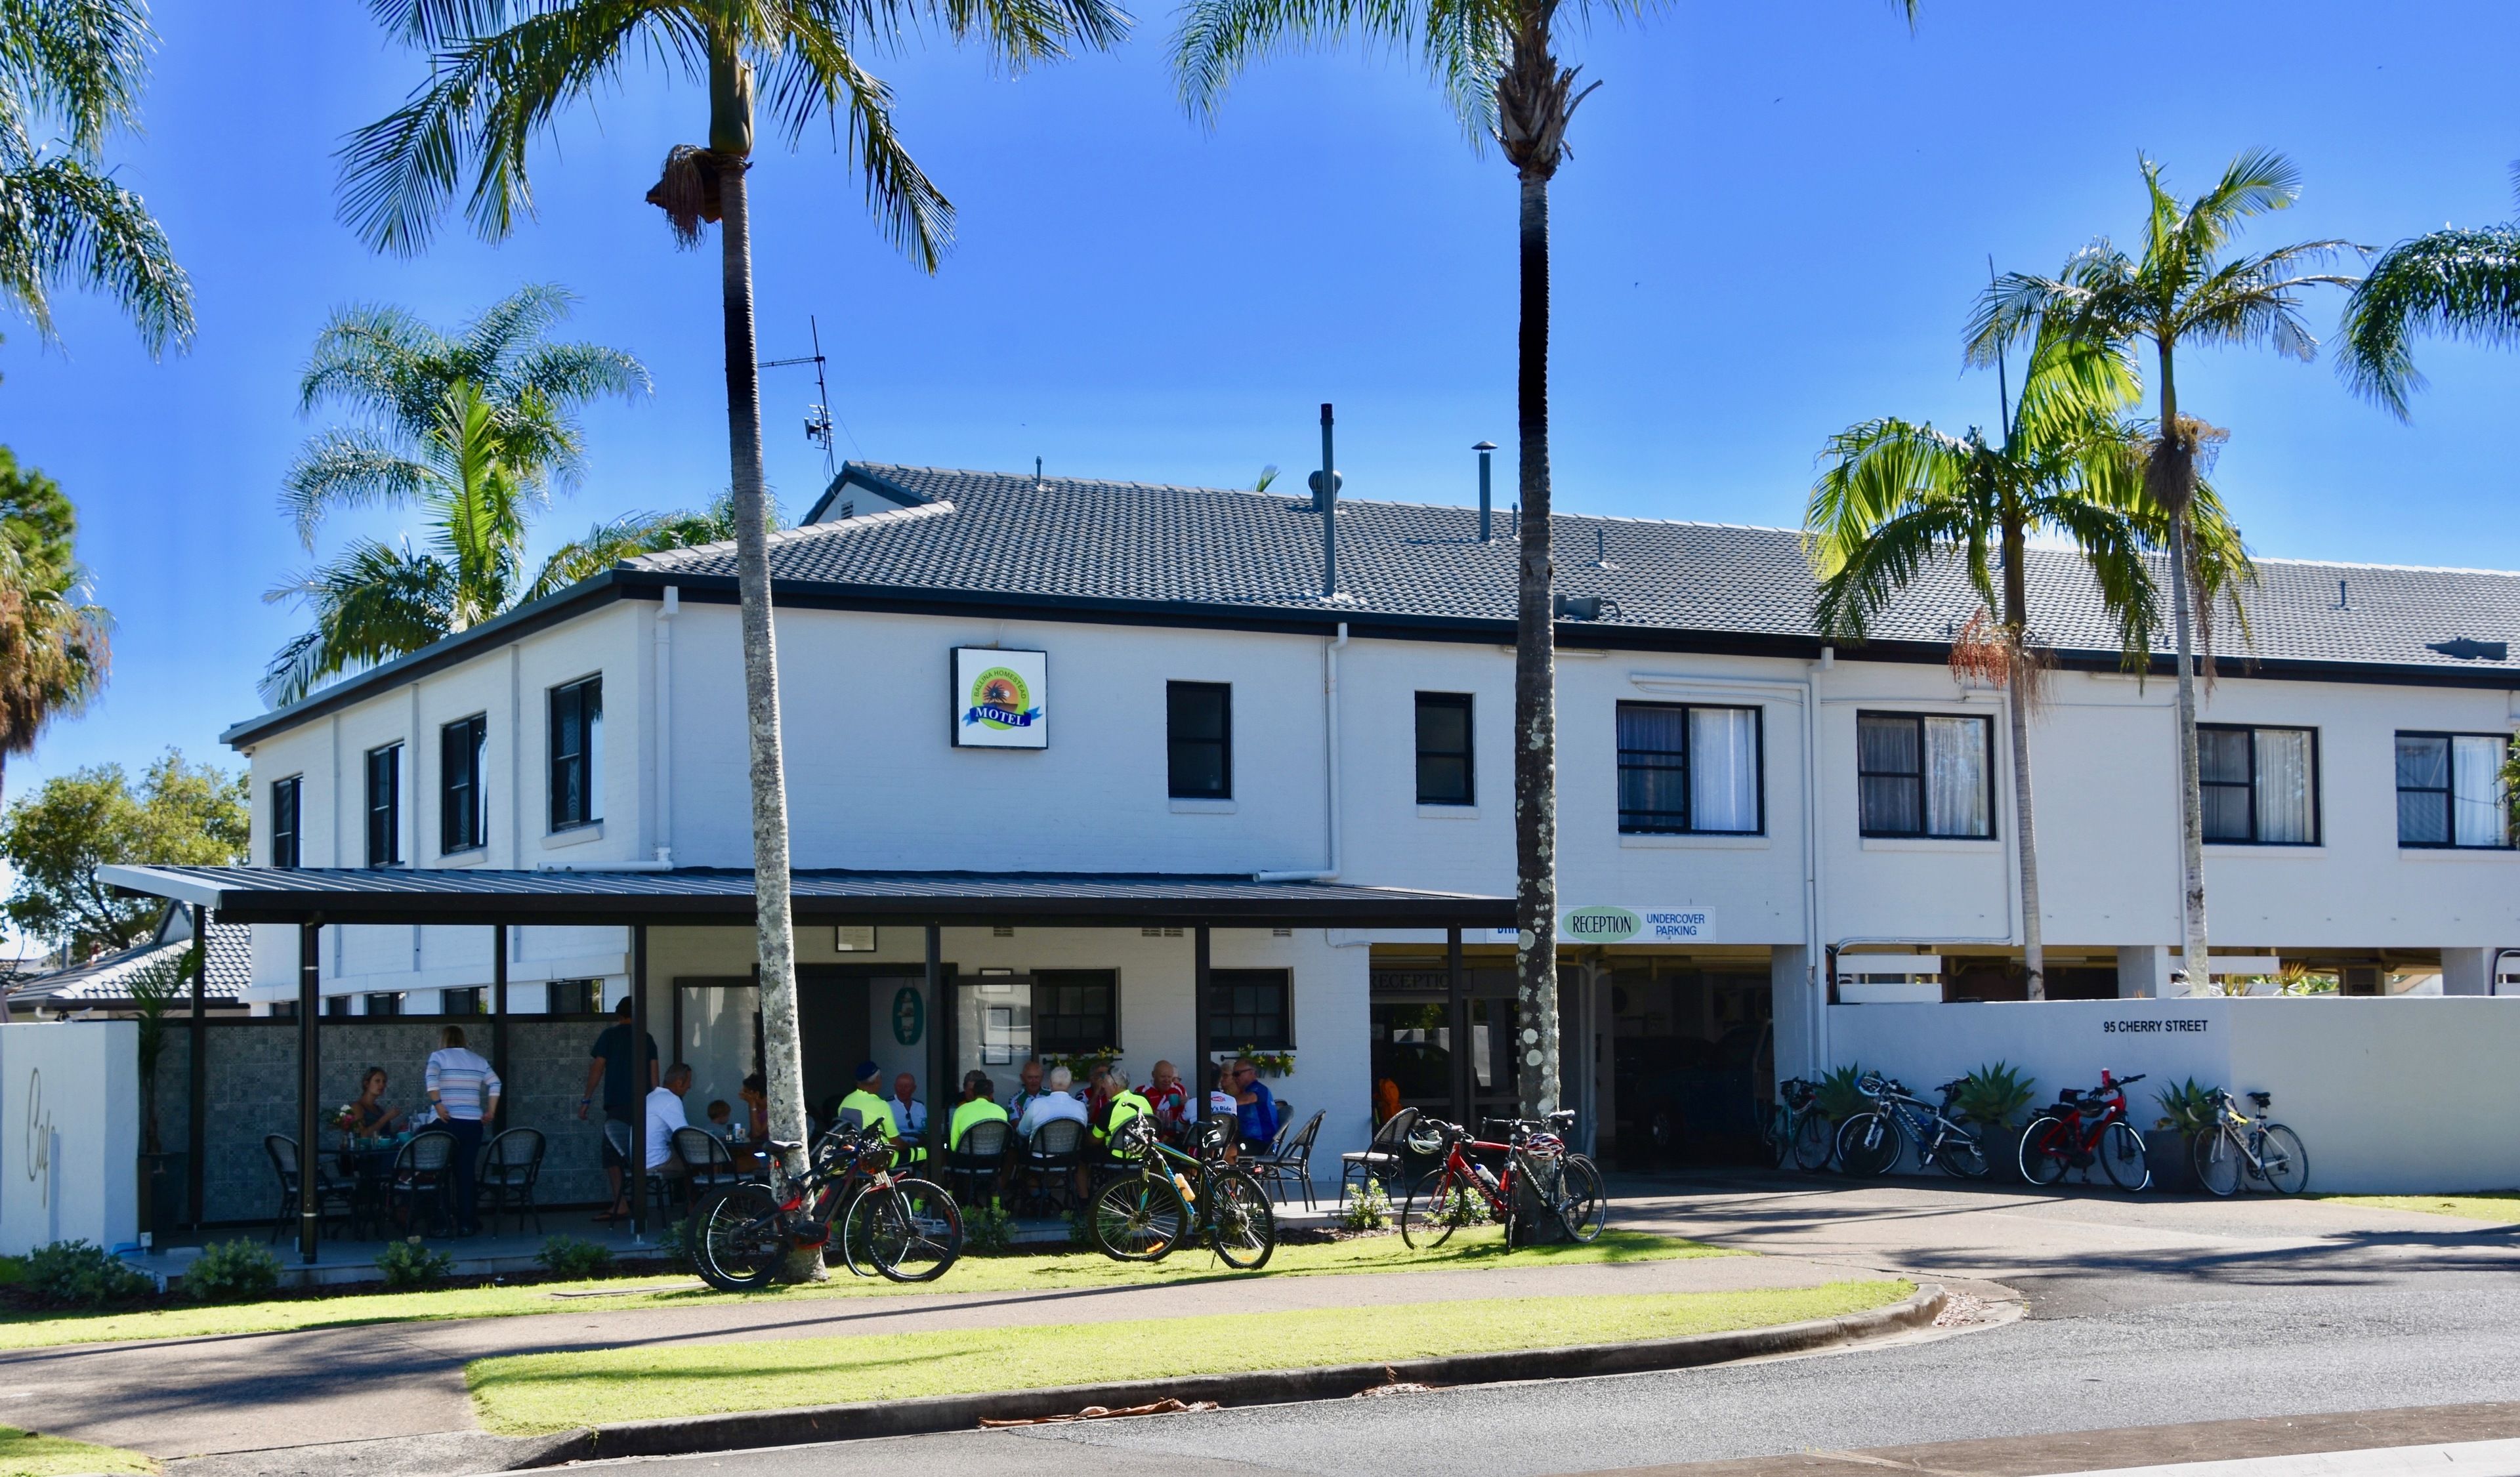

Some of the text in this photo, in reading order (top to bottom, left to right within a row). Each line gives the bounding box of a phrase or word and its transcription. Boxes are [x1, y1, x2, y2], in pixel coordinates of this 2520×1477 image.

[974, 670, 1026, 699] BALLINA HOMESTEAD
[976, 707, 1024, 726] MOTEL
[1572, 915, 1632, 934] RECEPTION
[1647, 913, 1705, 925] UNDERCOVER
[1656, 925, 1697, 936] PARKING
[1369, 973, 1450, 988] RECEPTIO
[2103, 1020, 2208, 1033] 95 CHERRY STREET
[26, 1066, 56, 1209] Caf
